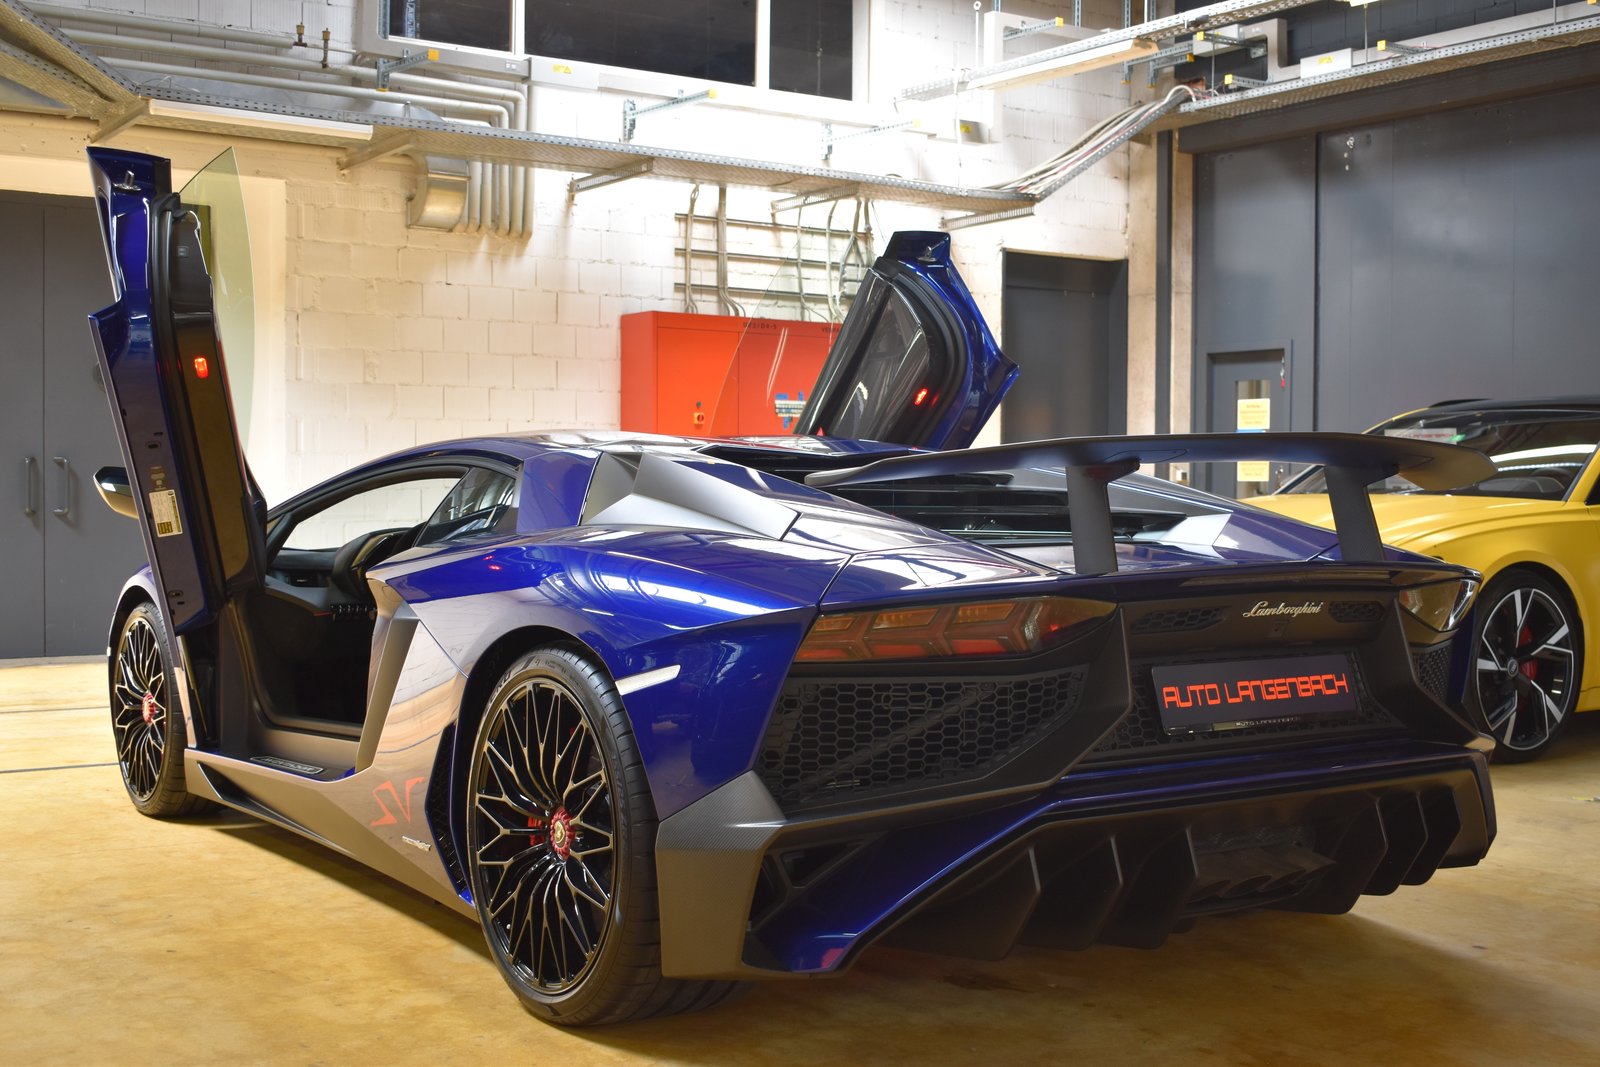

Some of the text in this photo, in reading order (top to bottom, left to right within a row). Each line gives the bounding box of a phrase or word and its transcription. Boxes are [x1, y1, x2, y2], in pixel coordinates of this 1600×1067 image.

[1242, 601, 1324, 618] Lamborghini
[1162, 673, 1348, 708] AUTO LANGENBACH
